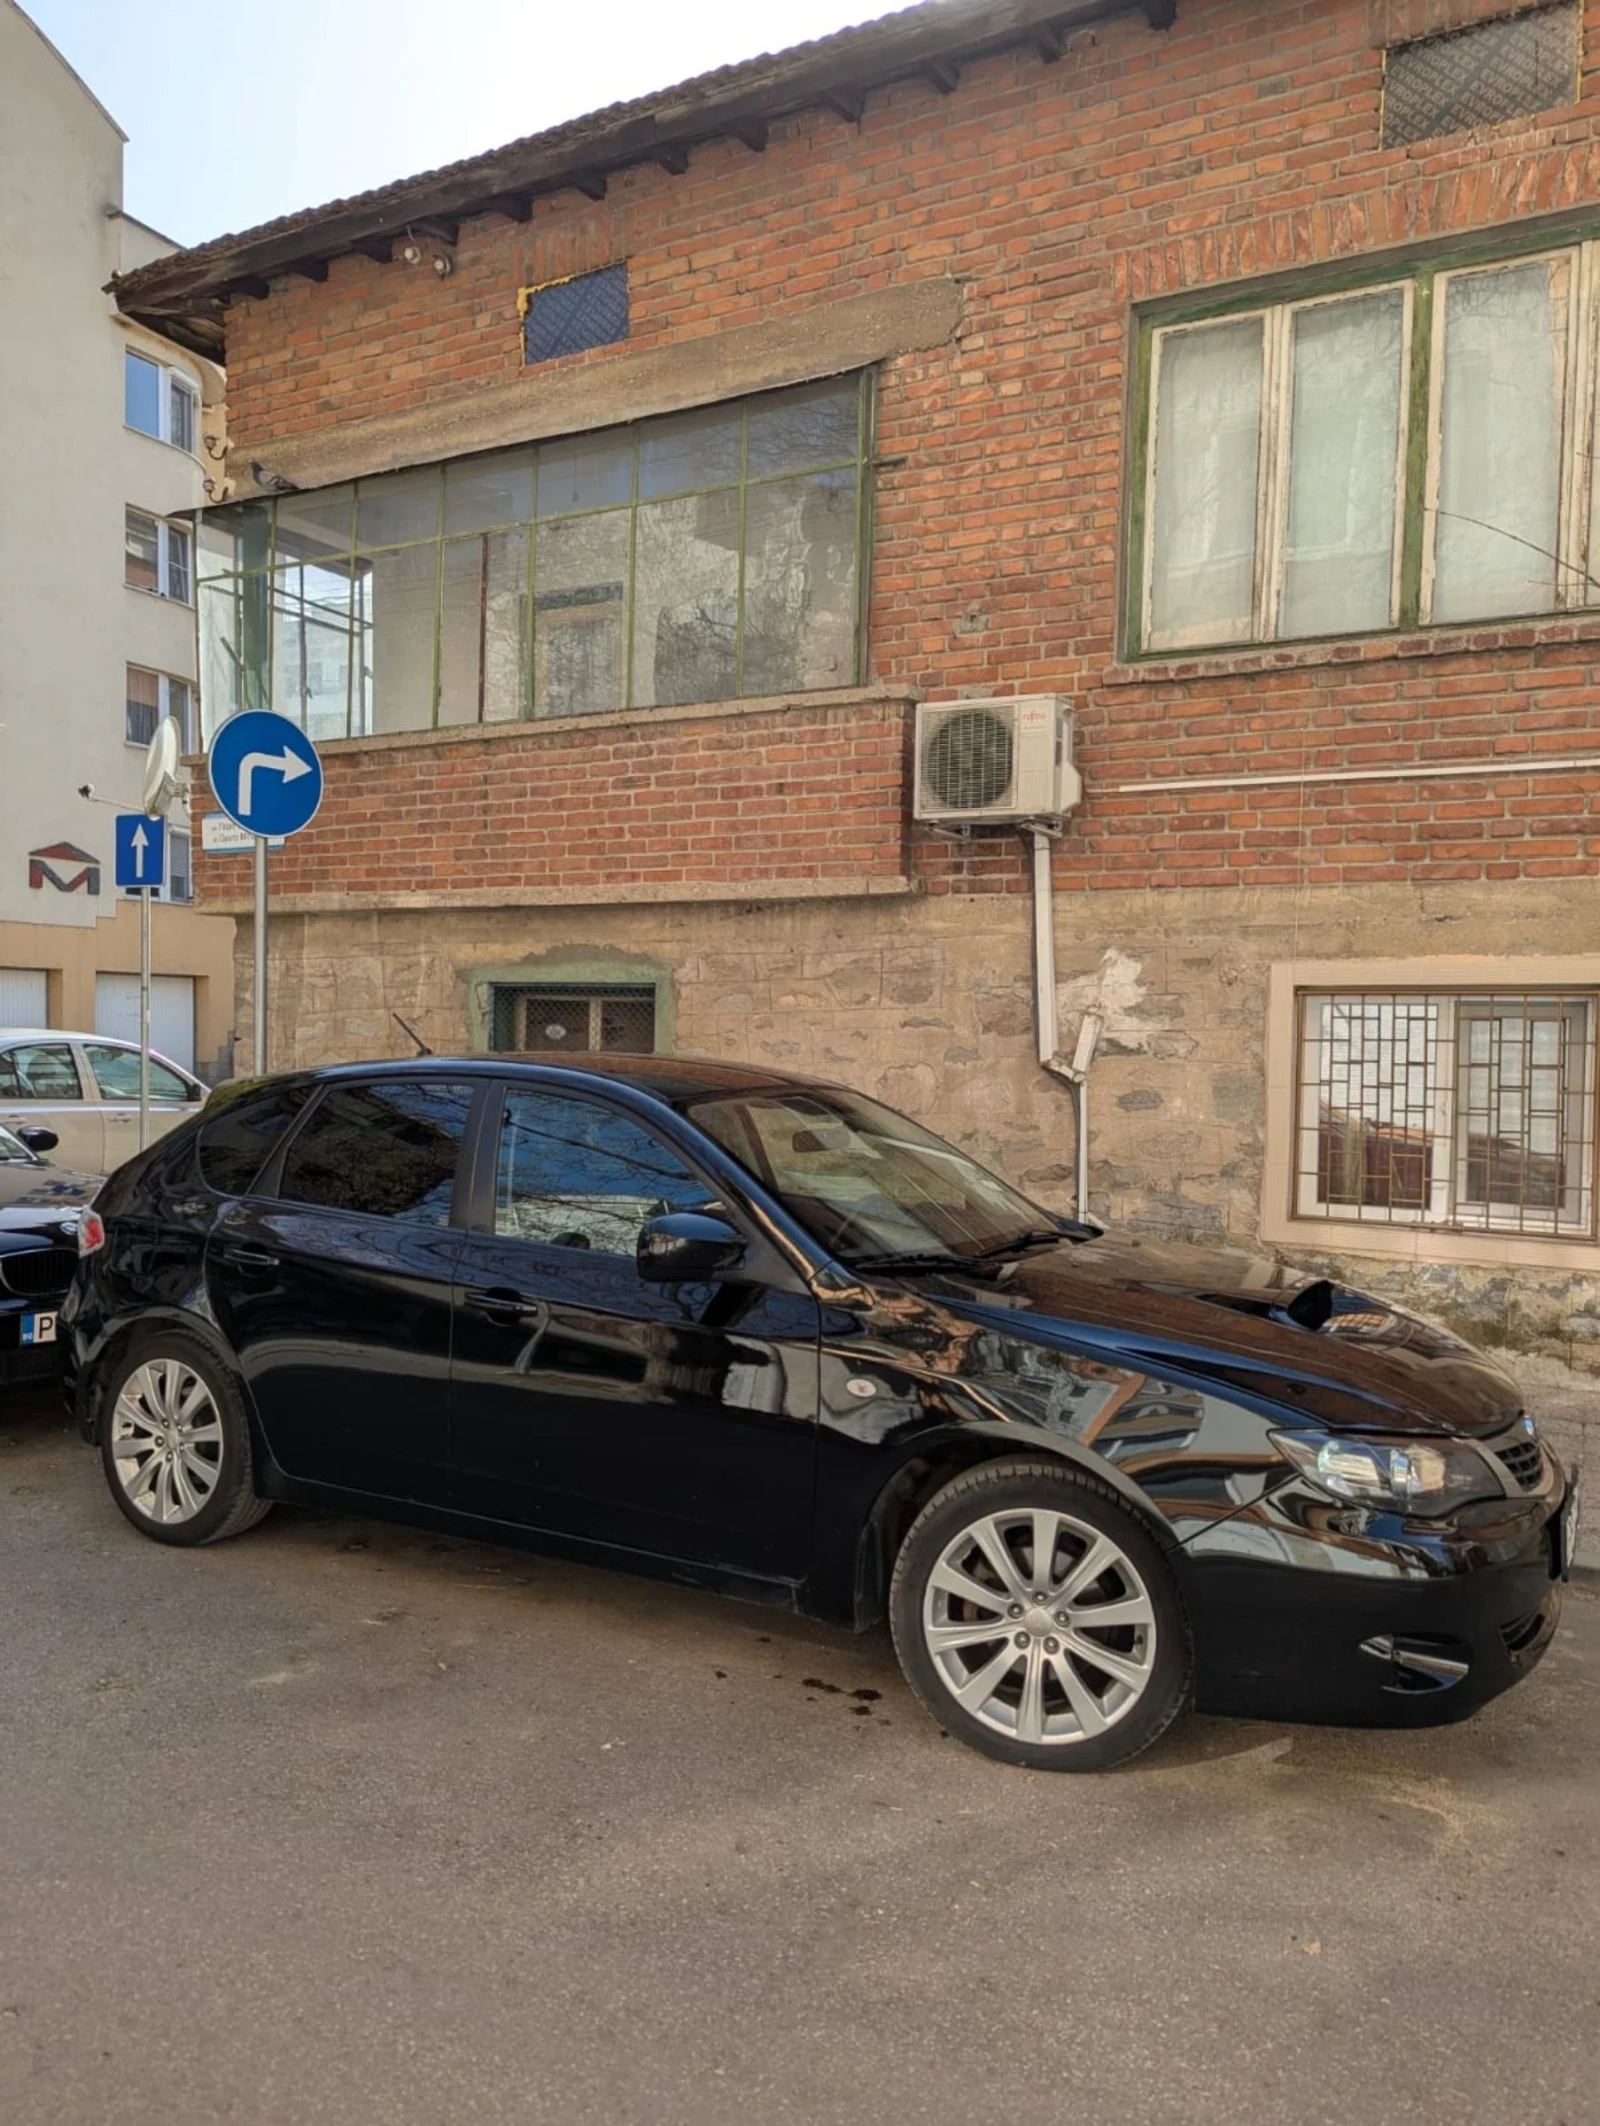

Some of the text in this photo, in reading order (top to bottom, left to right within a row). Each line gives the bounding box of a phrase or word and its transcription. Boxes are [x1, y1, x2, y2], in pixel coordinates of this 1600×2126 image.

[1400, 53, 1460, 94] EVROPLEX
[1409, 42, 1469, 84] EVROPLEX
[1489, 55, 1553, 98] EVROPLEX
[1390, 64, 1449, 107] EVROPLEX
[1480, 67, 1542, 110] EVROPLEX
[39, 1316, 53, 1339] P
